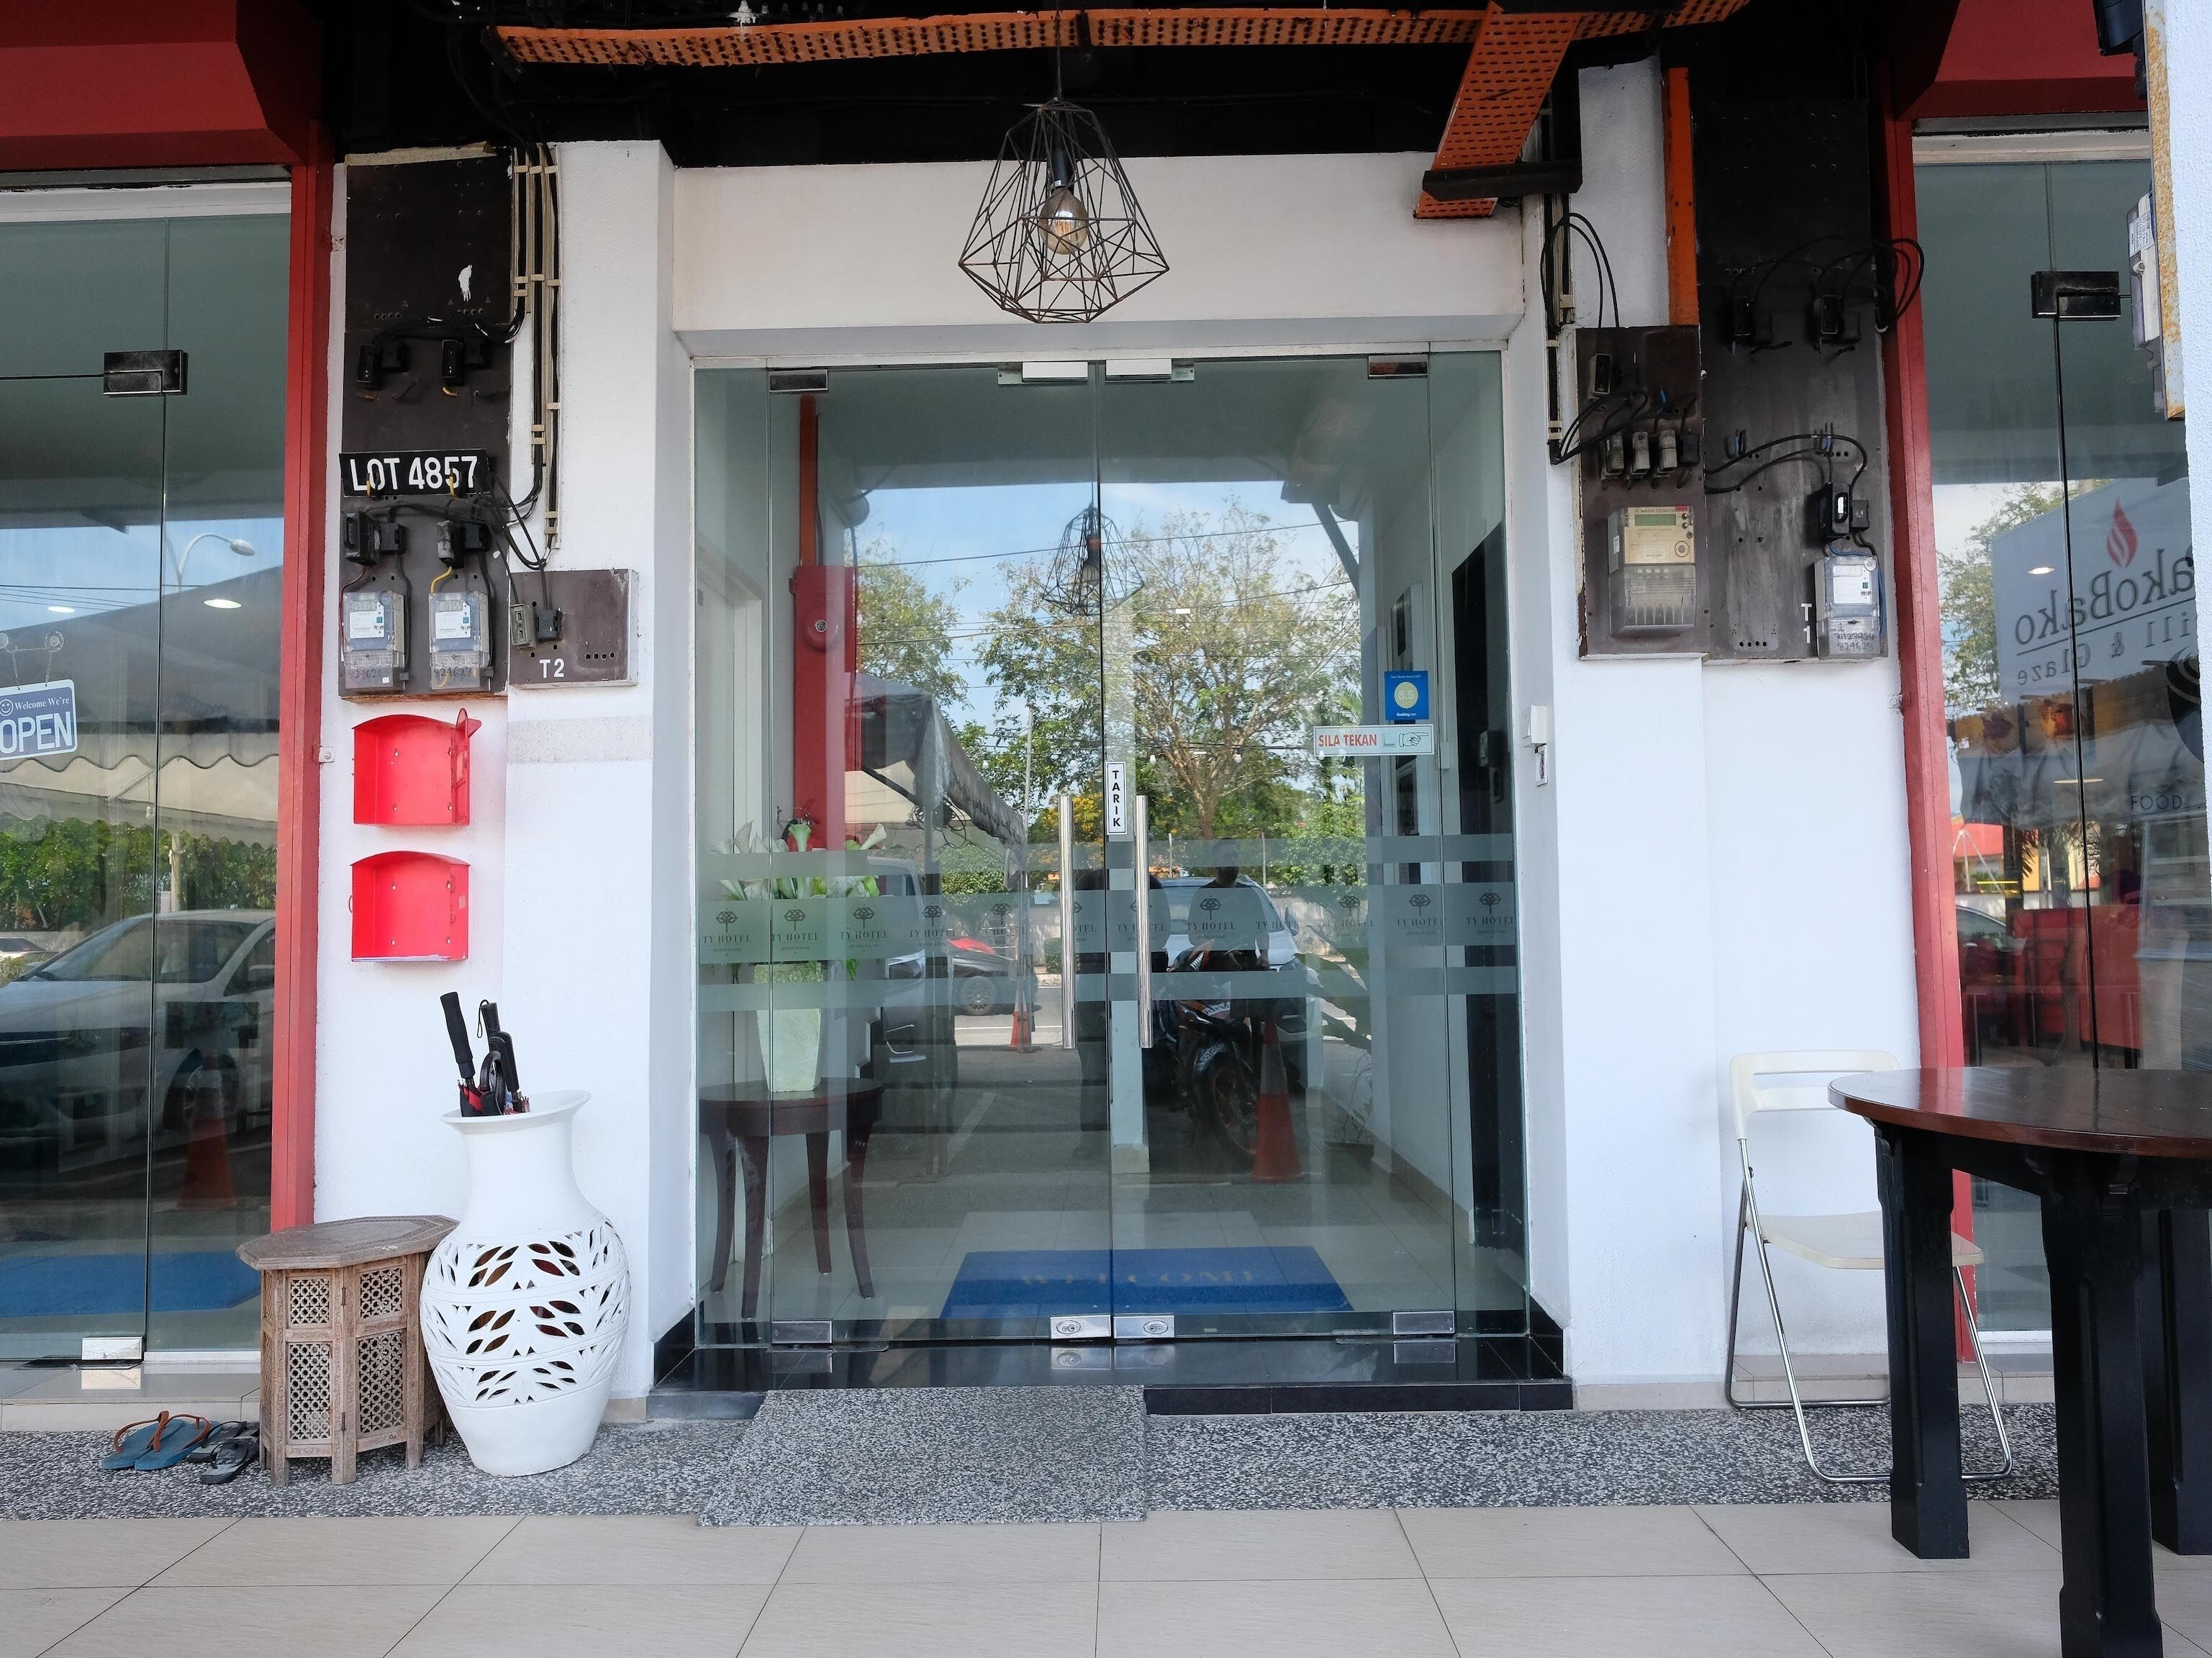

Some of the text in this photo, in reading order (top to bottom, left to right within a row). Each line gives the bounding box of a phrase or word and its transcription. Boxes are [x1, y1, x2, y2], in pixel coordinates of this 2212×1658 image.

[350, 456, 478, 491] LOT 4857
[1398, 690, 1415, 700] 8.5
[14, 696, 70, 710] Welcome We're
[0, 711, 73, 754] OPEN
[1318, 733, 1377, 747] SILA TEKAN
[1112, 770, 1121, 827] TARIK
[2131, 794, 2183, 811] FOOD
[1202, 922, 1237, 930] HOTEL
[702, 934, 751, 943] TY HOTEL
[787, 932, 818, 941] HOTEL
[855, 930, 889, 939] HOTEL
